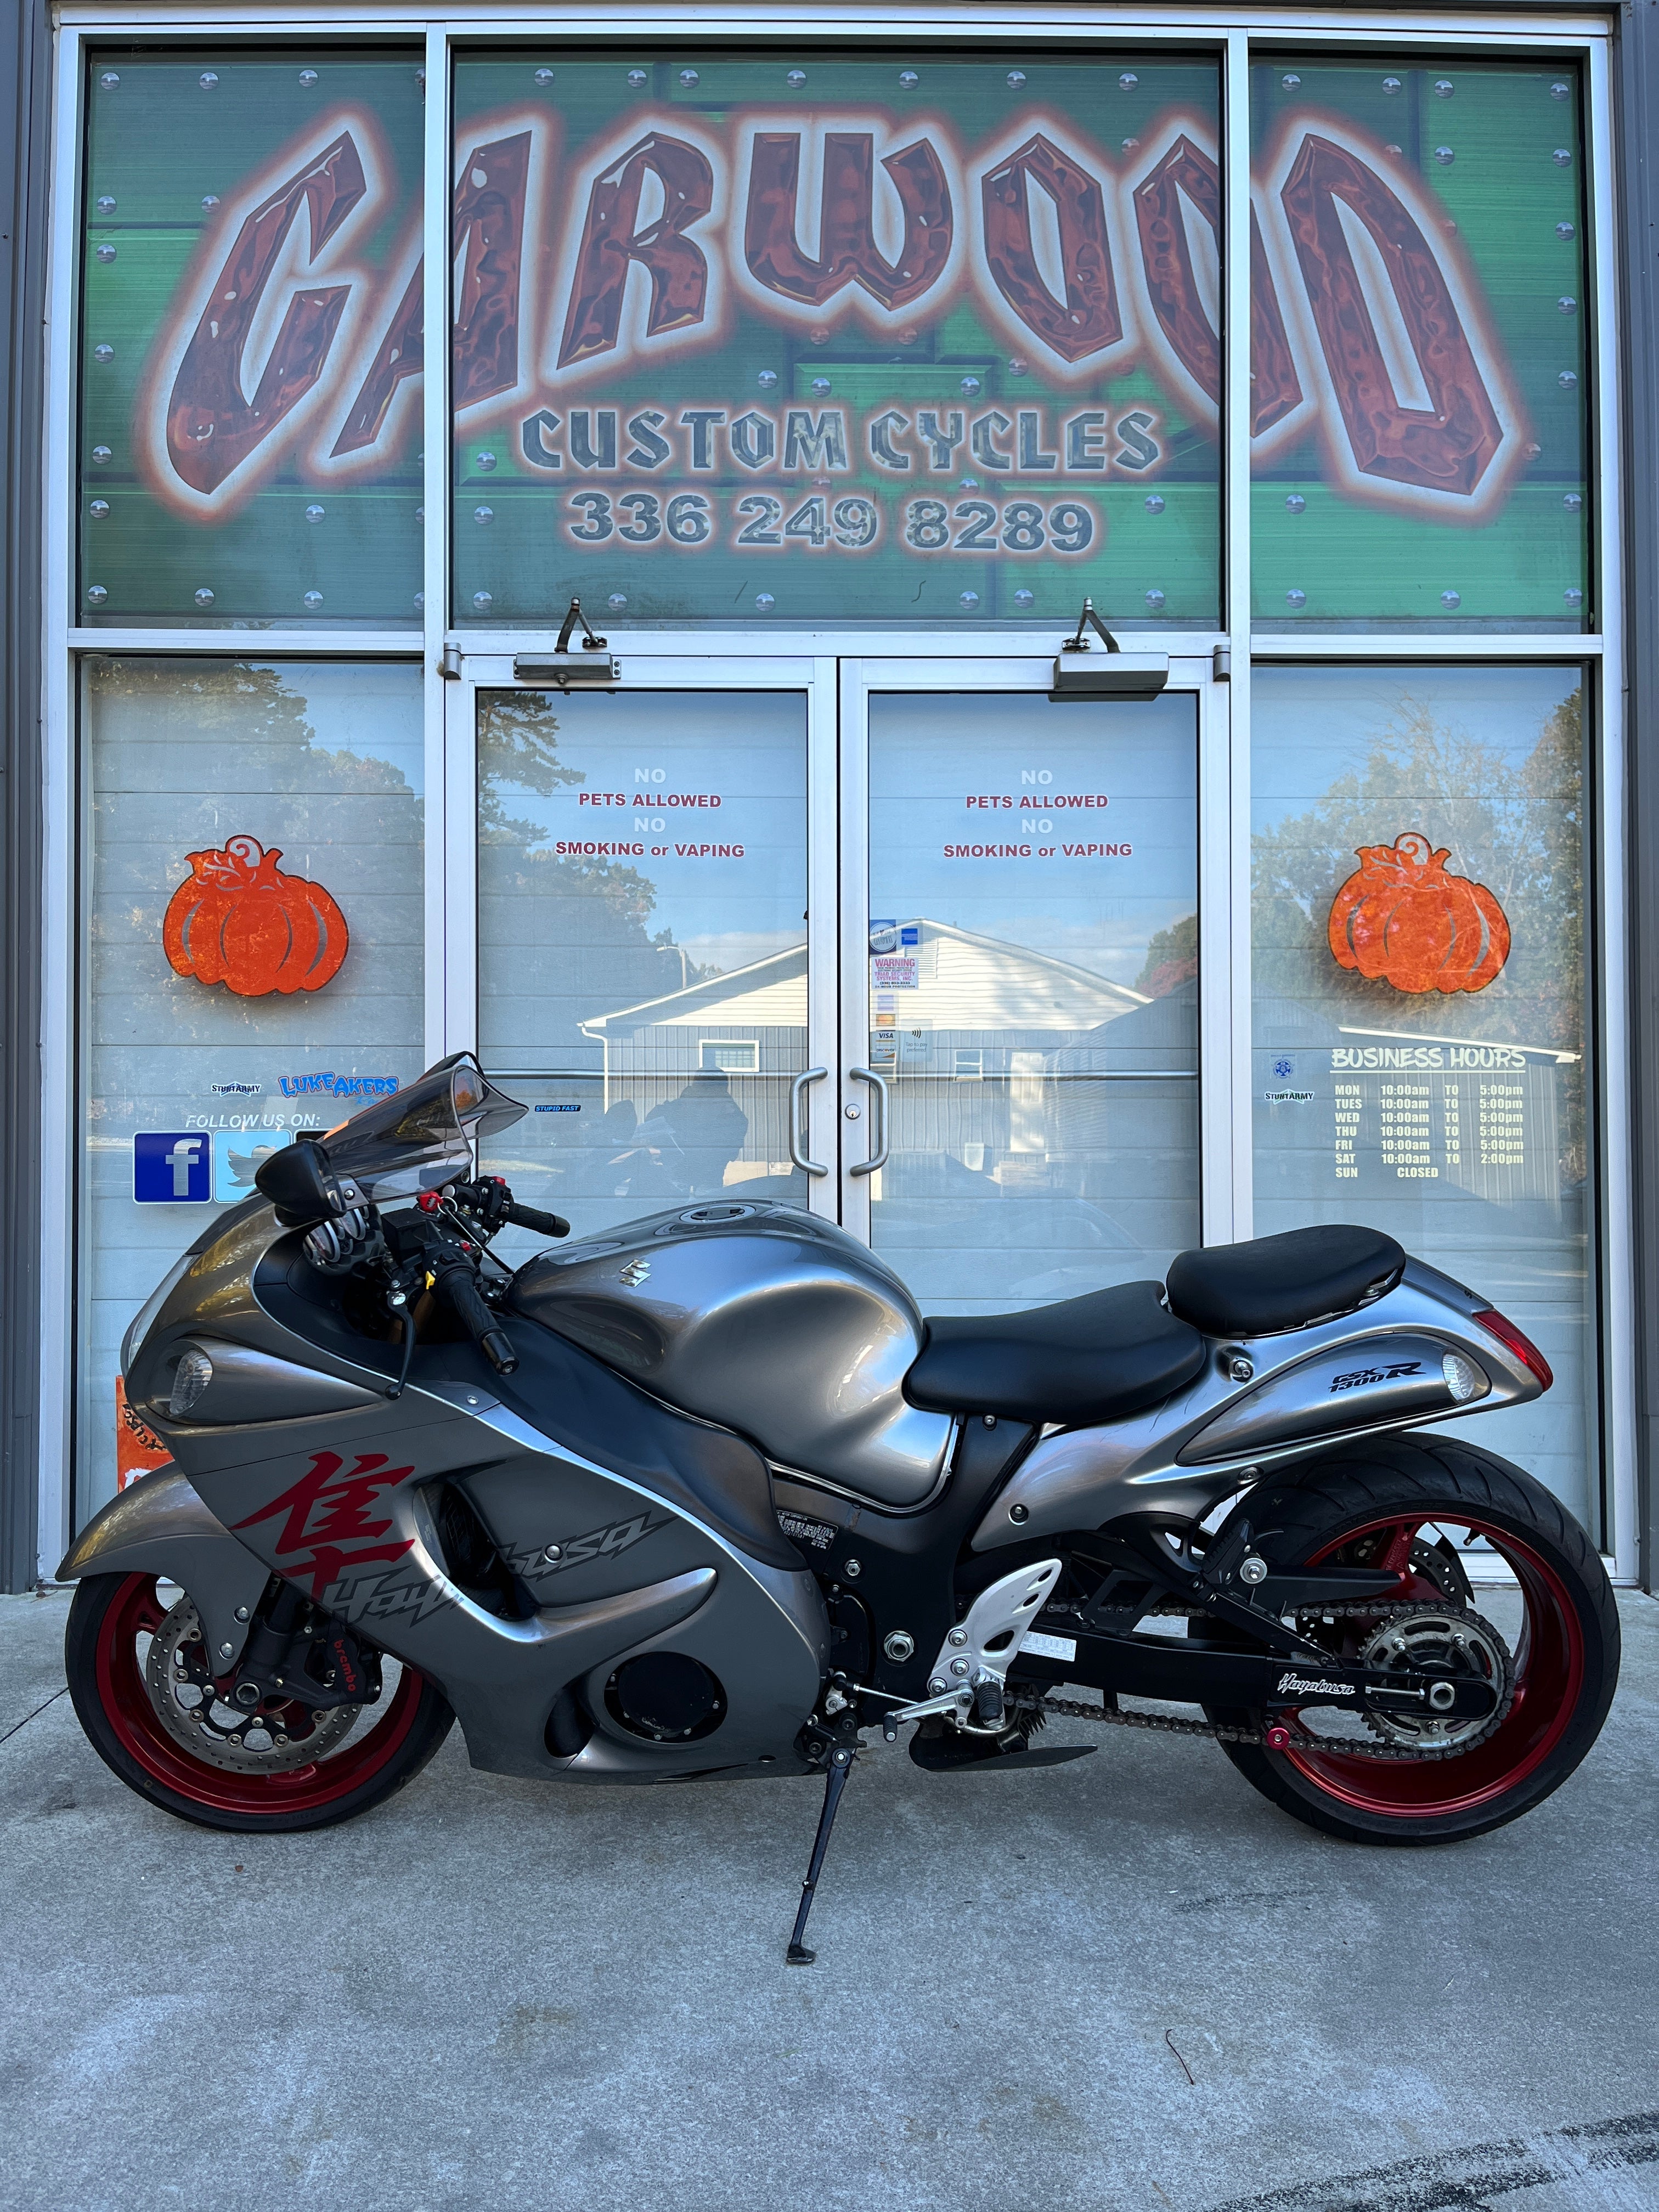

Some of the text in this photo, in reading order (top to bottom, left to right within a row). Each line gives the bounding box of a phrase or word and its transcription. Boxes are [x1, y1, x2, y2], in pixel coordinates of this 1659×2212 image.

[166, 131, 1504, 495] GARWOOD
[522, 409, 1159, 470] CUSTOM CYCLES
[570, 493, 1093, 552] 336 249 8289
[635, 768, 666, 783] NO
[1022, 770, 1053, 785] NO
[579, 793, 721, 808] PETS ALLOWED
[966, 795, 1108, 809] PETS ALLOWED
[634, 817, 666, 833] NO
[1022, 819, 1053, 834] NO
[556, 842, 745, 857] SMOKING or VAPING
[944, 843, 1132, 857] SMOKING or VAPING
[1331, 1048, 1526, 1068] BUSINESS HOURS
[1335, 1085, 1523, 1096] MON 10:00am TO 5:00pm
[1335, 1099, 1523, 1110] TUES 10:00am TO 5:00pm
[186, 1114, 320, 1128] FOLLOW US ON:
[1335, 1113, 1523, 1124] WED 10:00am TO 5:00pm
[1335, 1126, 1523, 1137] THU 10:00am TO 5:00pm
[1335, 1140, 1523, 1151] FRI 10:00am TO 5:00pm
[1335, 1154, 1523, 1165] SAT 10:00am TO 2:00pm
[1335, 1167, 1438, 1177] SUN CLOSED
[1329, 1374, 1386, 1393] 1300
[228, 1451, 415, 1605] 隼
[334, 1639, 356, 1691] brembo
[1278, 1673, 1356, 1694] Hayabusa
